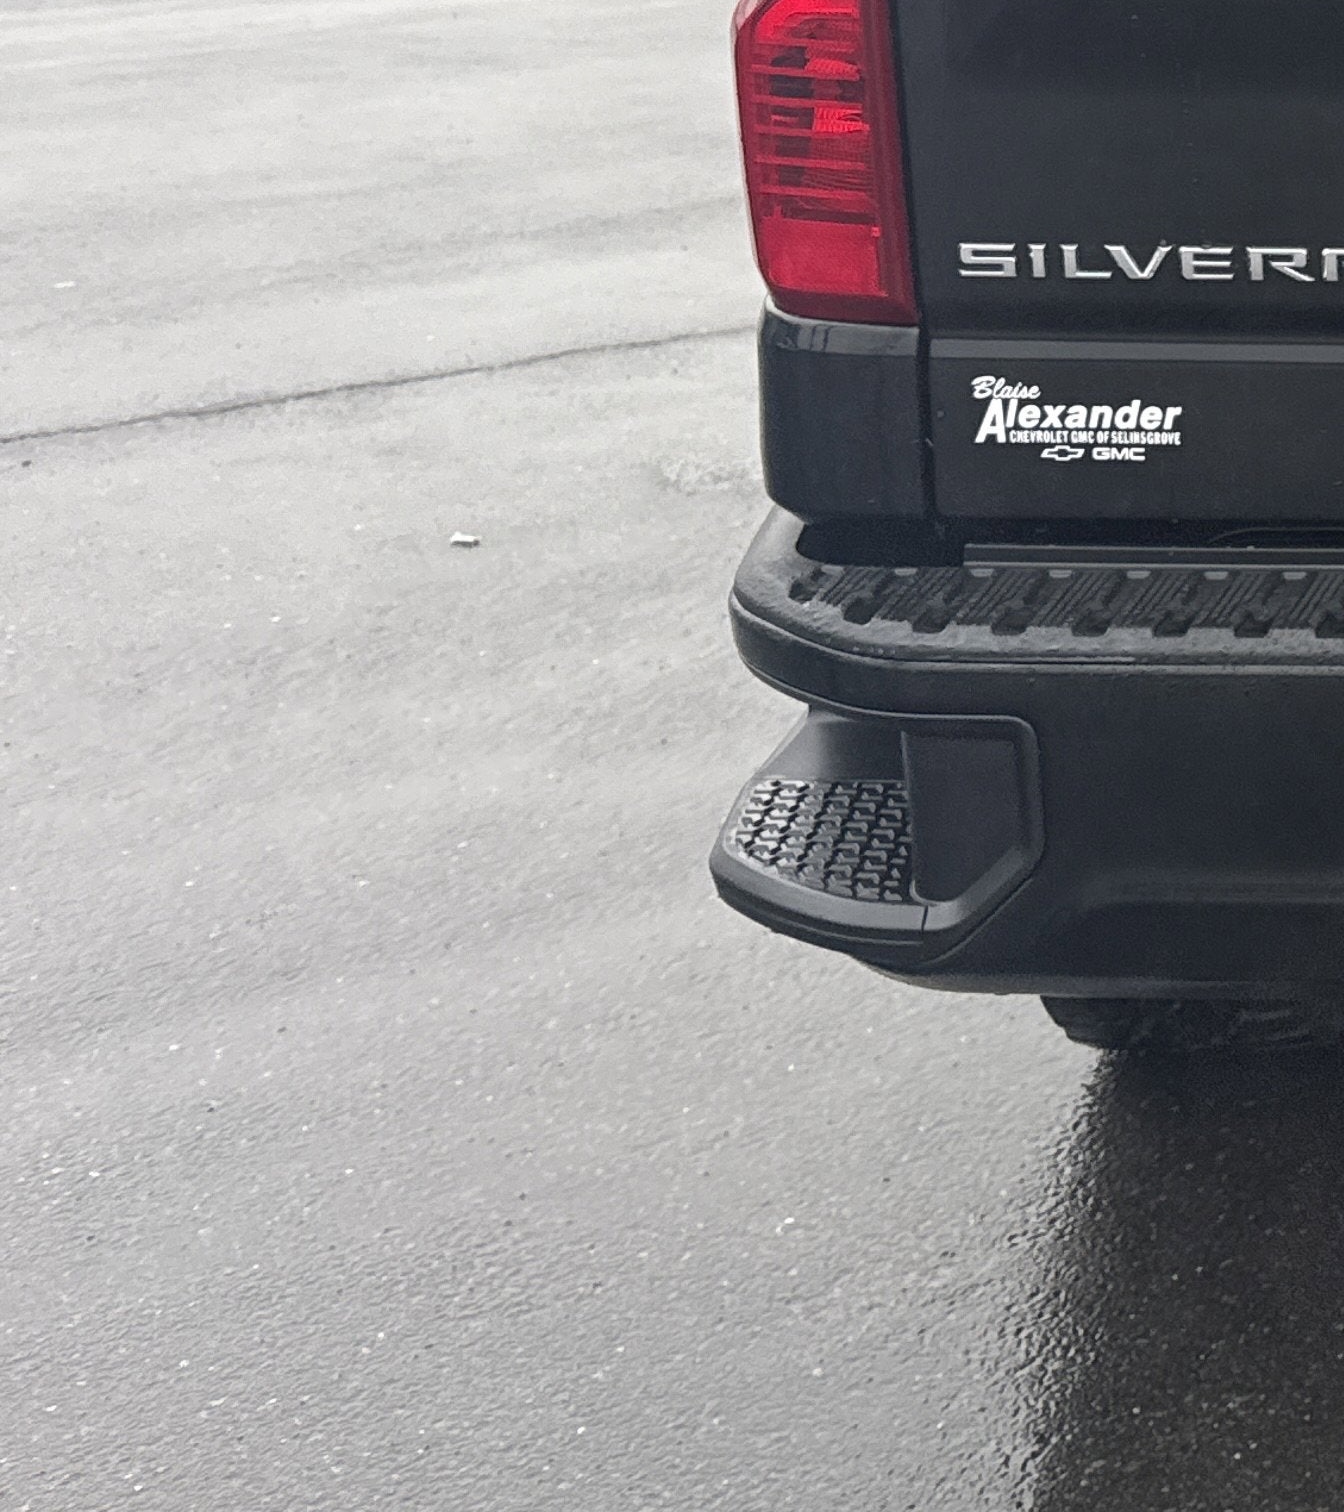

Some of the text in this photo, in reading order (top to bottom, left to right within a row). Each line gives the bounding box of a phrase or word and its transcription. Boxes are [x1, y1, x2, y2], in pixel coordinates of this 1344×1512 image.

[971, 375, 1041, 399] Blaise
[974, 398, 1183, 444] Alexander
[1008, 430, 1182, 446] CHEVROLET GMC OF SELINSGROVE
[1092, 446, 1146, 461] GMC
